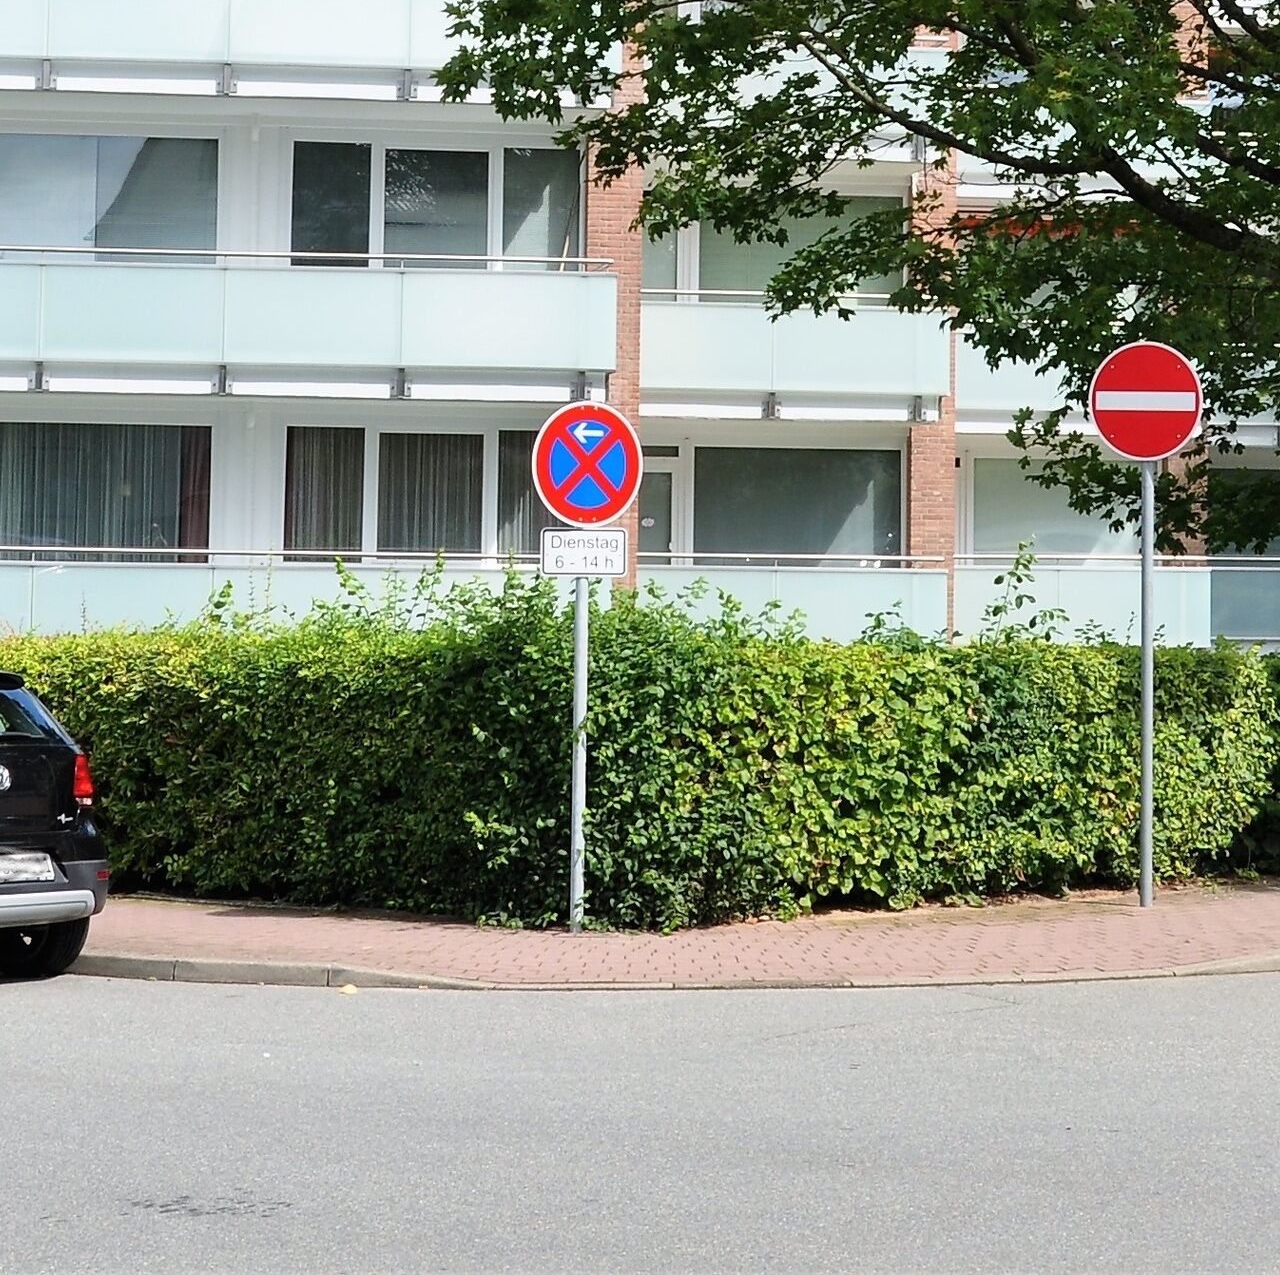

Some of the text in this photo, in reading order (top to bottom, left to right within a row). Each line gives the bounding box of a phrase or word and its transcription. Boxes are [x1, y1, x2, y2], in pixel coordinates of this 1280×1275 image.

[551, 534, 619, 553] Dienstag
[555, 555, 565, 569] 6
[583, 555, 598, 569] 14
[605, 556, 614, 569] h
